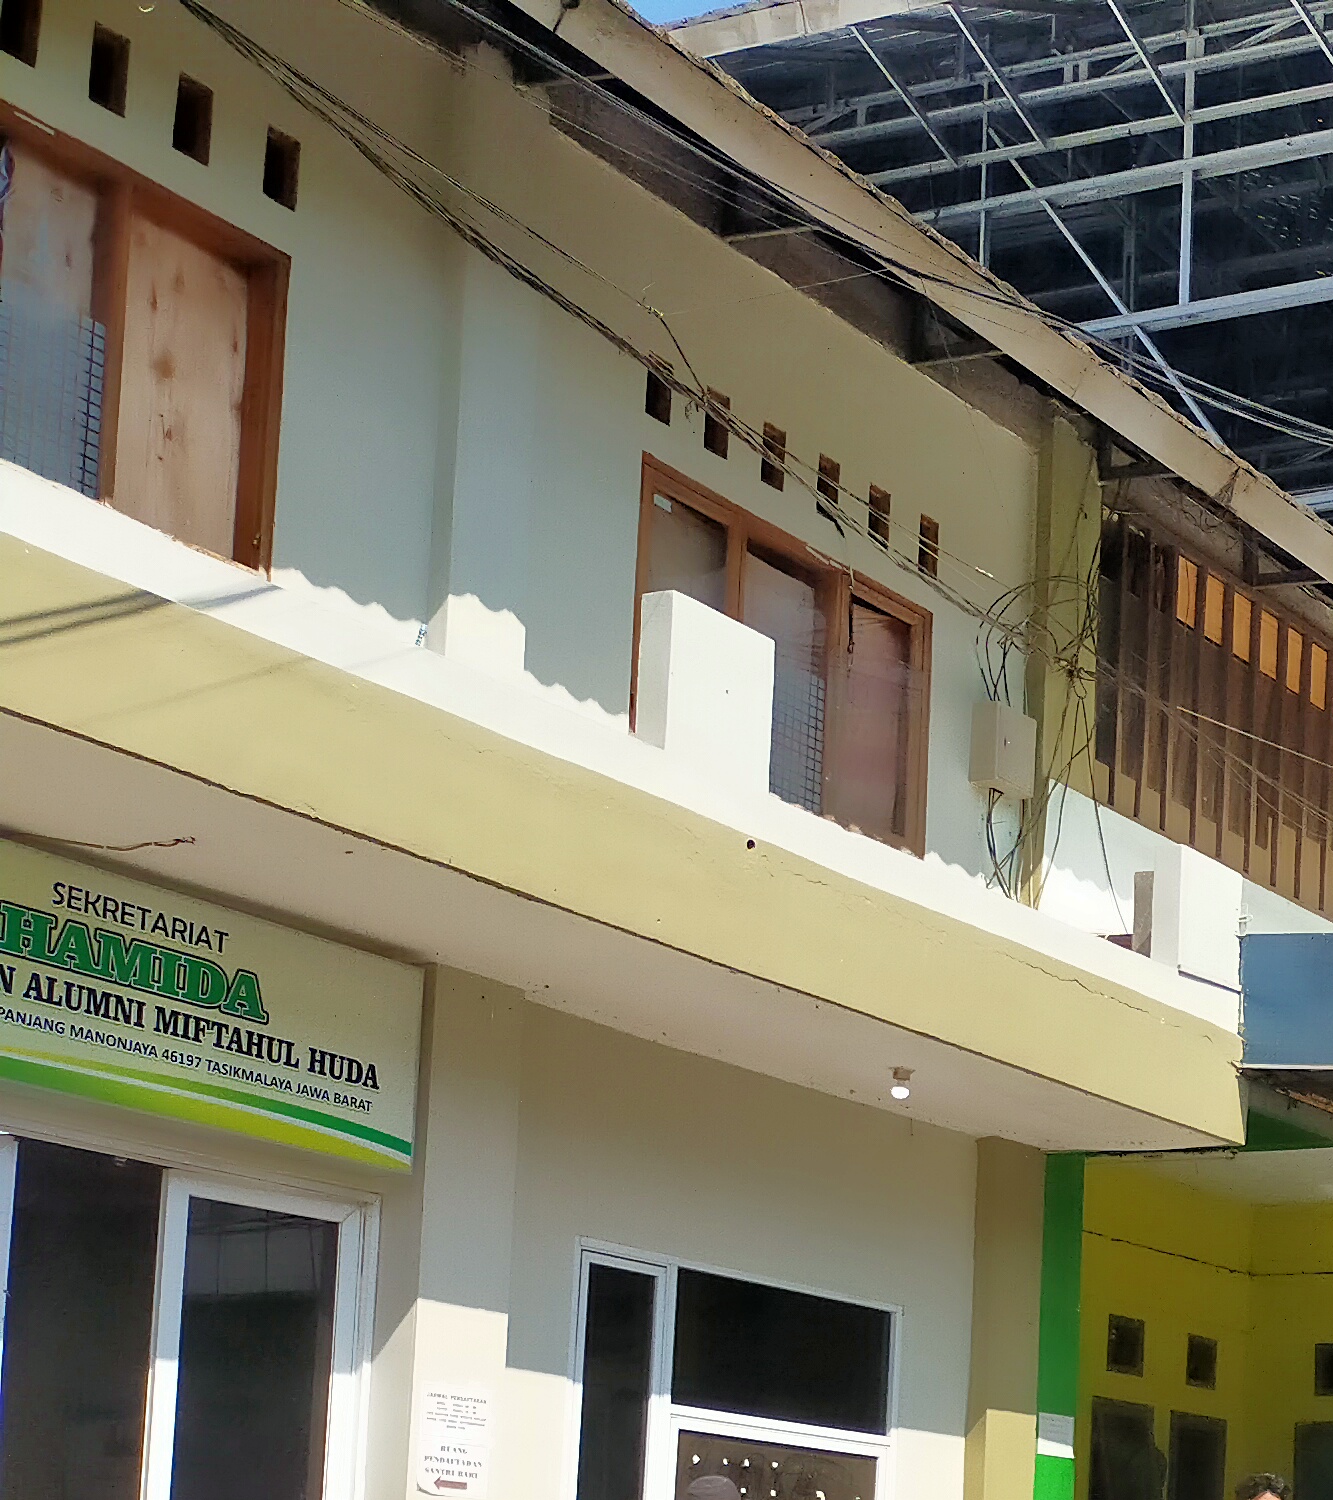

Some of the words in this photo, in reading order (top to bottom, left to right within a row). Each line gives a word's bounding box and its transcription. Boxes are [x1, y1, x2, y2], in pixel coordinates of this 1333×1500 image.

[0, 899, 269, 1025] HAMIDA
[52, 881, 229, 953] SEKRETARIAT
[23, 972, 146, 1029] ALUMNI
[153, 1005, 300, 1069] MIFTAHUL
[307, 1046, 380, 1090] HUDA
[70, 1024, 158, 1058] MANONJAYA
[161, 1049, 202, 1068] 46197
[205, 1059, 293, 1092] TASIKMALAYA
[296, 1082, 330, 1102] JAWA
[333, 1092, 373, 1112] BARAT
